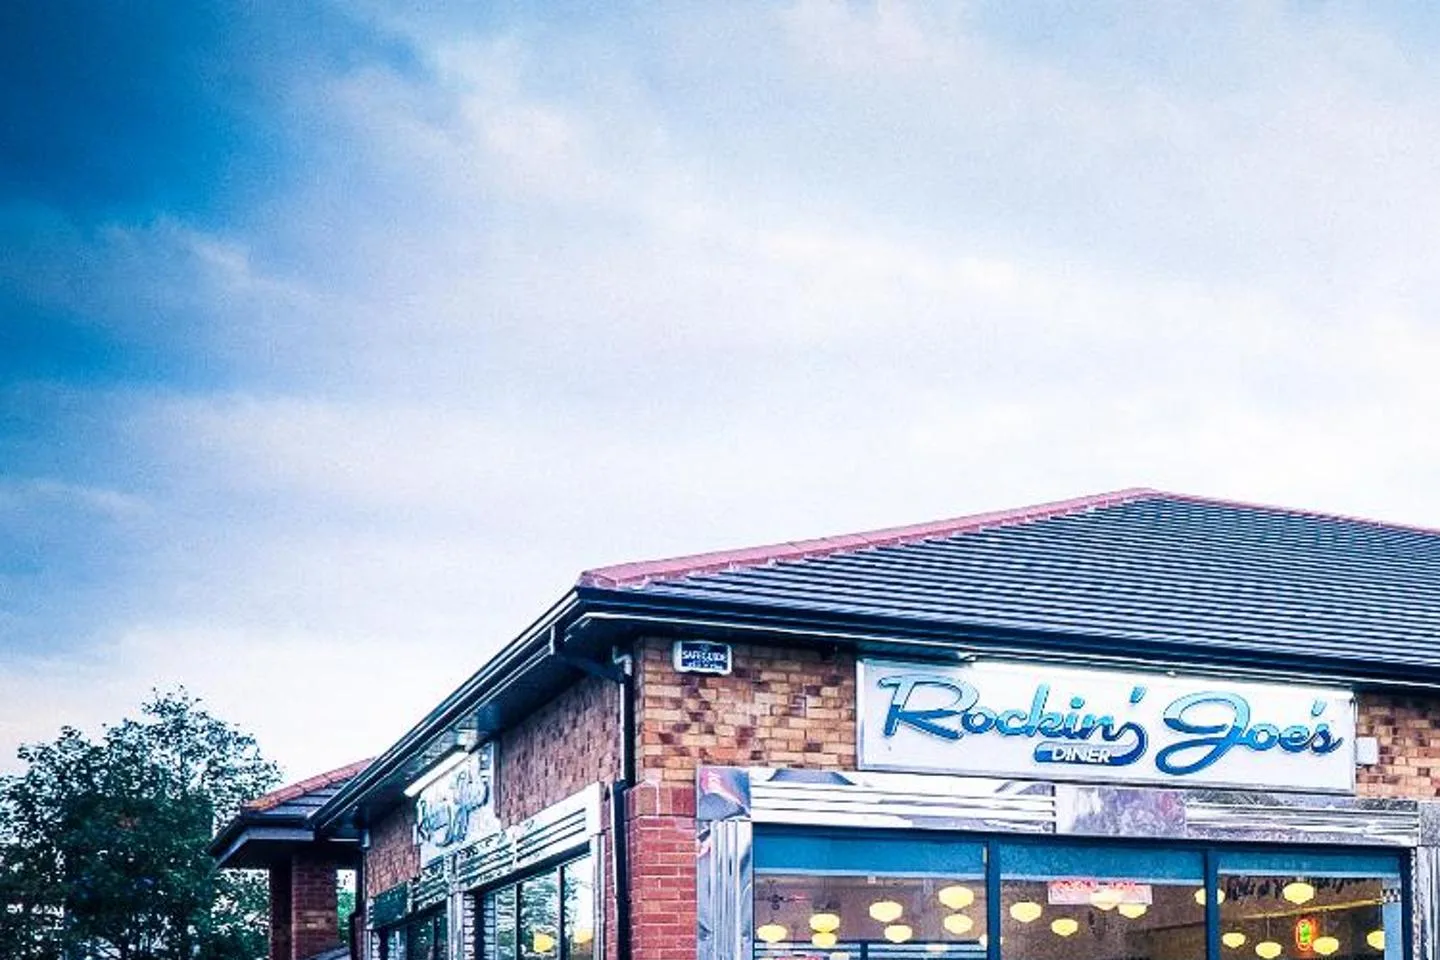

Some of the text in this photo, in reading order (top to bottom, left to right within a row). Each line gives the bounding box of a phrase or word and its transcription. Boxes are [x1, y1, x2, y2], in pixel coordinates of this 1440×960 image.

[877, 674, 1346, 776] Rockin' Joe's
[1051, 747, 1112, 763] DINER
